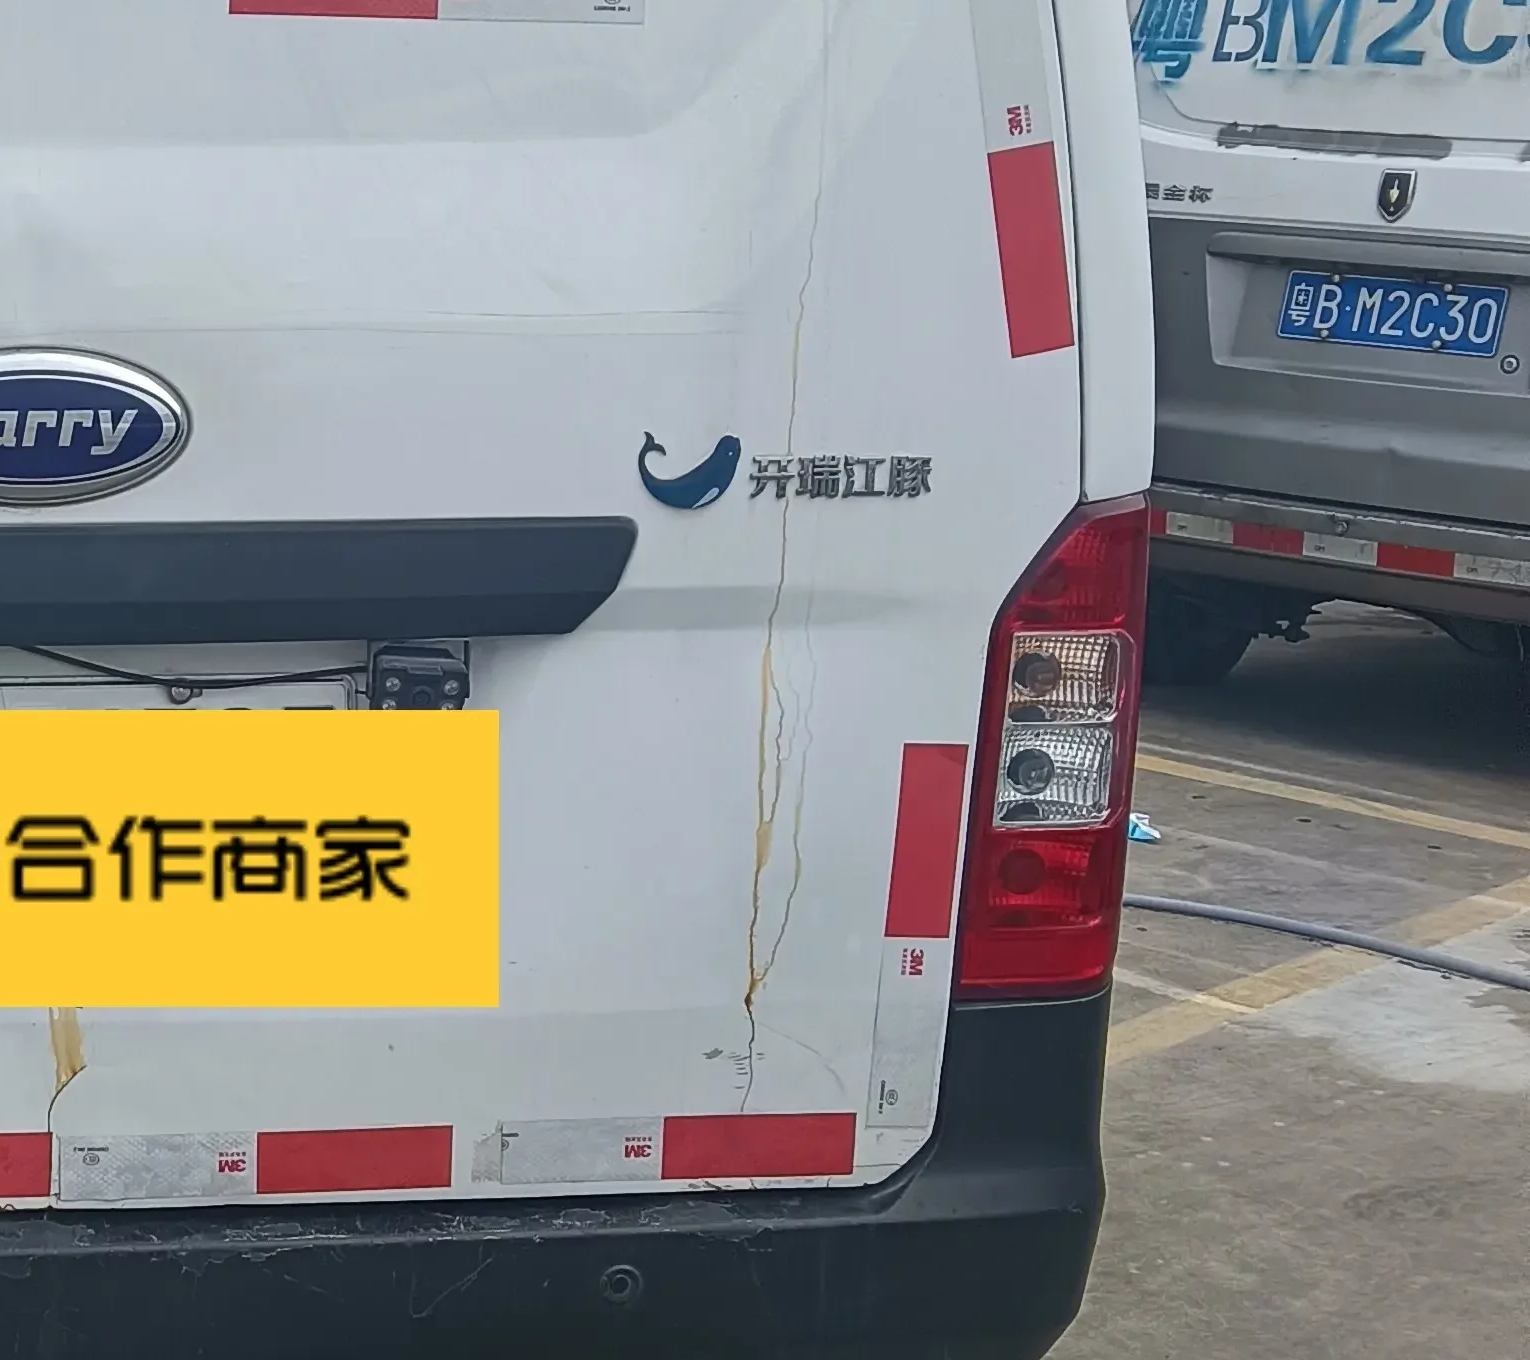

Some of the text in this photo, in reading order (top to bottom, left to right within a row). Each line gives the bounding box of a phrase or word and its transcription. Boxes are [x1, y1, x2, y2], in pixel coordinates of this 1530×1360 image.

[1007, 104, 1023, 136] 3M
[749, 454, 933, 498] 开瑞江豚
[908, 948, 924, 976] 3M
[624, 1144, 652, 1158] 3M
[218, 1159, 246, 1173] 3M
